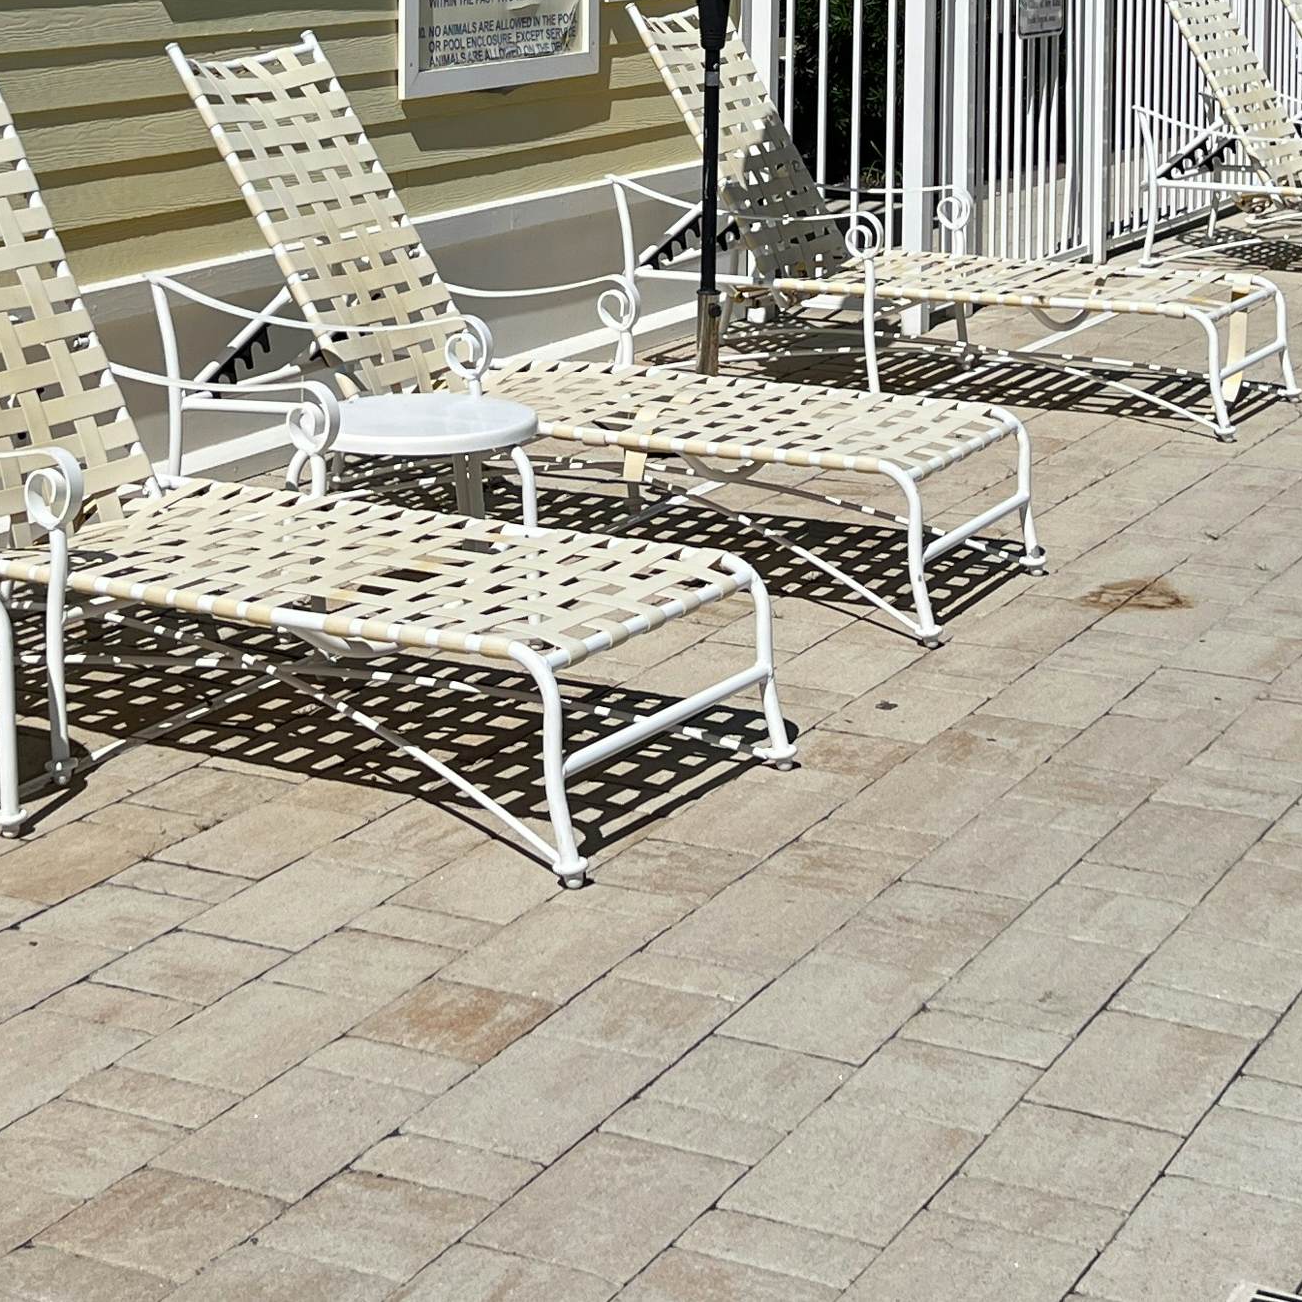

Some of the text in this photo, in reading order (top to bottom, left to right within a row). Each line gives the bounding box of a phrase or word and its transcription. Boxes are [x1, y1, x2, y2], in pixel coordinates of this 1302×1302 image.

[429, 26, 441, 38] NO
[443, 22, 477, 36] ANIMALS
[478, 20, 494, 31] ARE
[496, 17, 532, 30] ALLOWED
[533, 16, 540, 26] IN
[543, 14, 556, 26] THE
[429, 40, 442, 53] OR
[443, 38, 464, 50] POOL
[516, 29, 544, 42] EXCEPT
[546, 26, 576, 40] SERVCE
